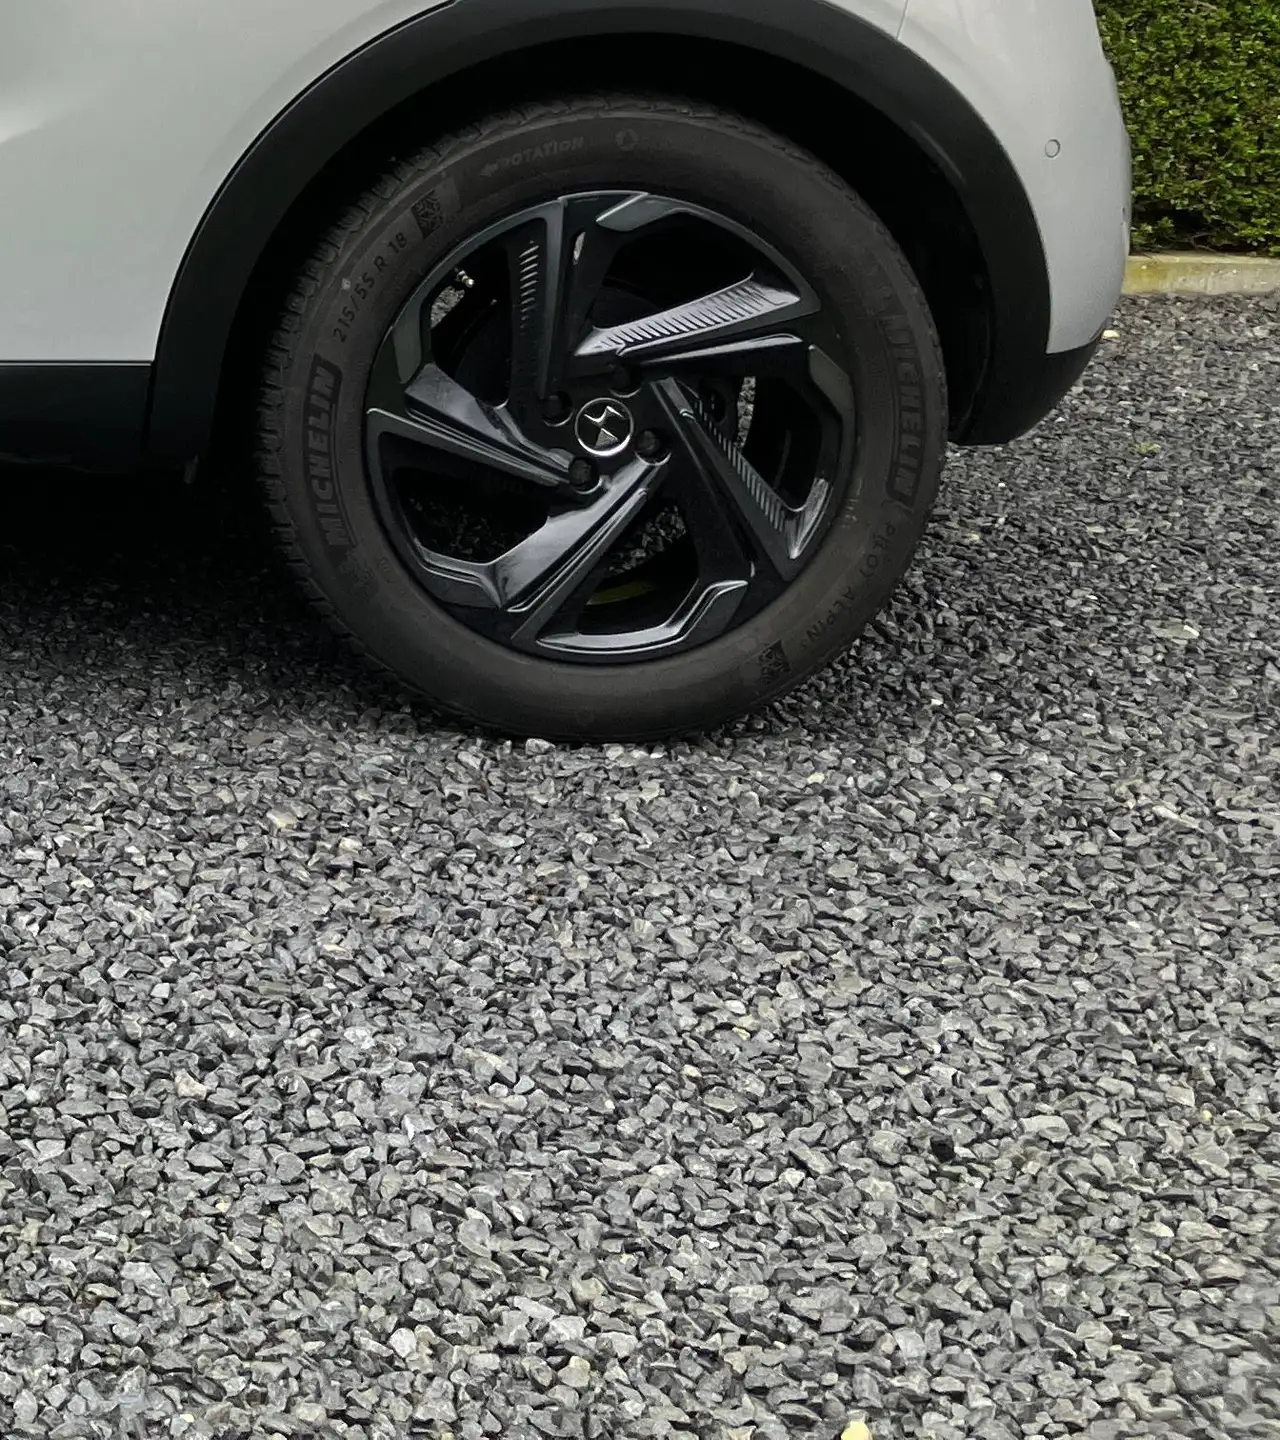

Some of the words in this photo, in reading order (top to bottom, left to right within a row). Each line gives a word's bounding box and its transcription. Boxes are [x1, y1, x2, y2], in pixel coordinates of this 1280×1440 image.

[333, 271, 376, 343] 215/55
[373, 254, 390, 275] R
[388, 232, 408, 254] 18
[308, 365, 351, 546] MICHELIN
